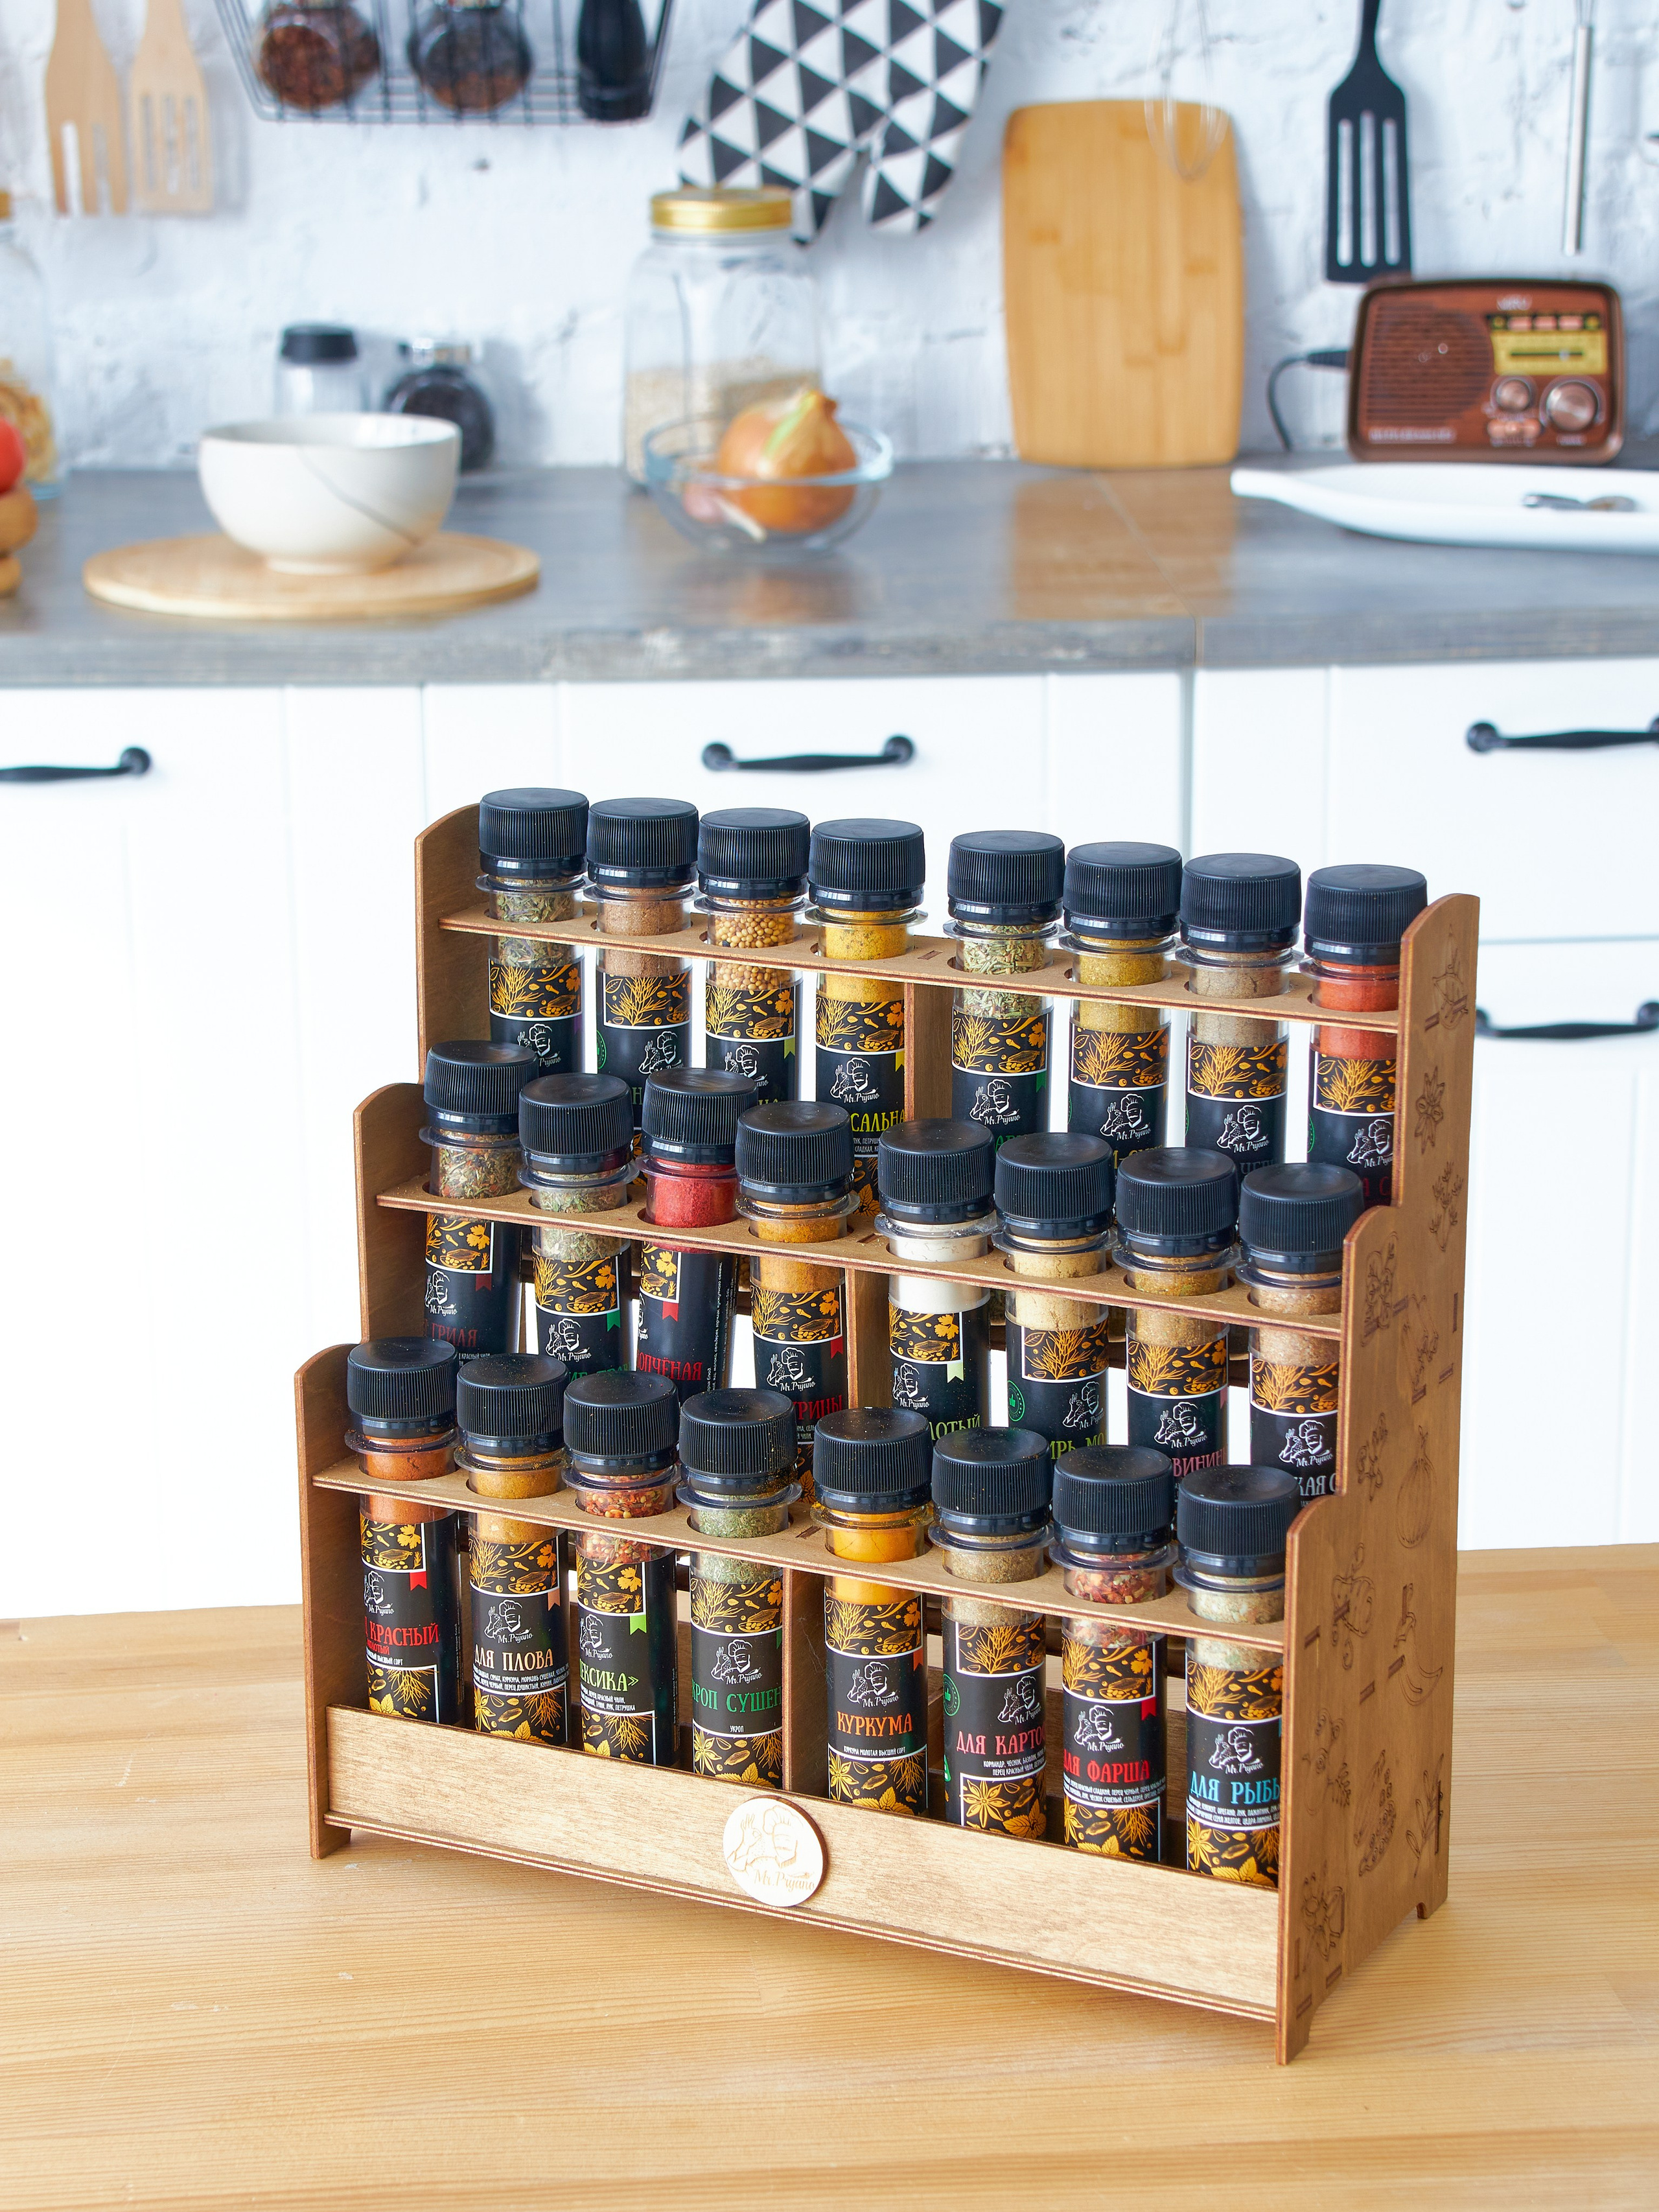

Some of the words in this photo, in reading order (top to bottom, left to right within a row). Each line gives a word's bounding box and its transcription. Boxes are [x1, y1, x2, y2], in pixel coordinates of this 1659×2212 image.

[850, 1109, 905, 1132] САЛЬНА
[637, 1348, 702, 1381] ОПЧЁНАЯ
[793, 1395, 842, 1421] РИЦЫ
[1172, 1449, 1223, 1478] ВИНИН
[369, 1621, 439, 1646] КРАСНЫЙ
[474, 1644, 494, 1669] ДЛЯ
[502, 1648, 553, 1671] ПЛОВА
[691, 1677, 718, 1710] КРОП
[726, 1686, 782, 1713] СУШЕН
[837, 1710, 913, 1737] КУРКУМА
[843, 1745, 859, 1755] КУРКУМА
[879, 1748, 896, 1756] ВЫСШИЙ
[897, 1746, 906, 1754] СОРТ
[956, 1730, 986, 1754] ДЛЯ
[995, 1724, 1045, 1755] КАРТО
[1006, 1765, 1024, 1775] КРАСНЫЙ
[1087, 1760, 1150, 1784] ФАРША
[1190, 1771, 1220, 1802] ДЛЯ
